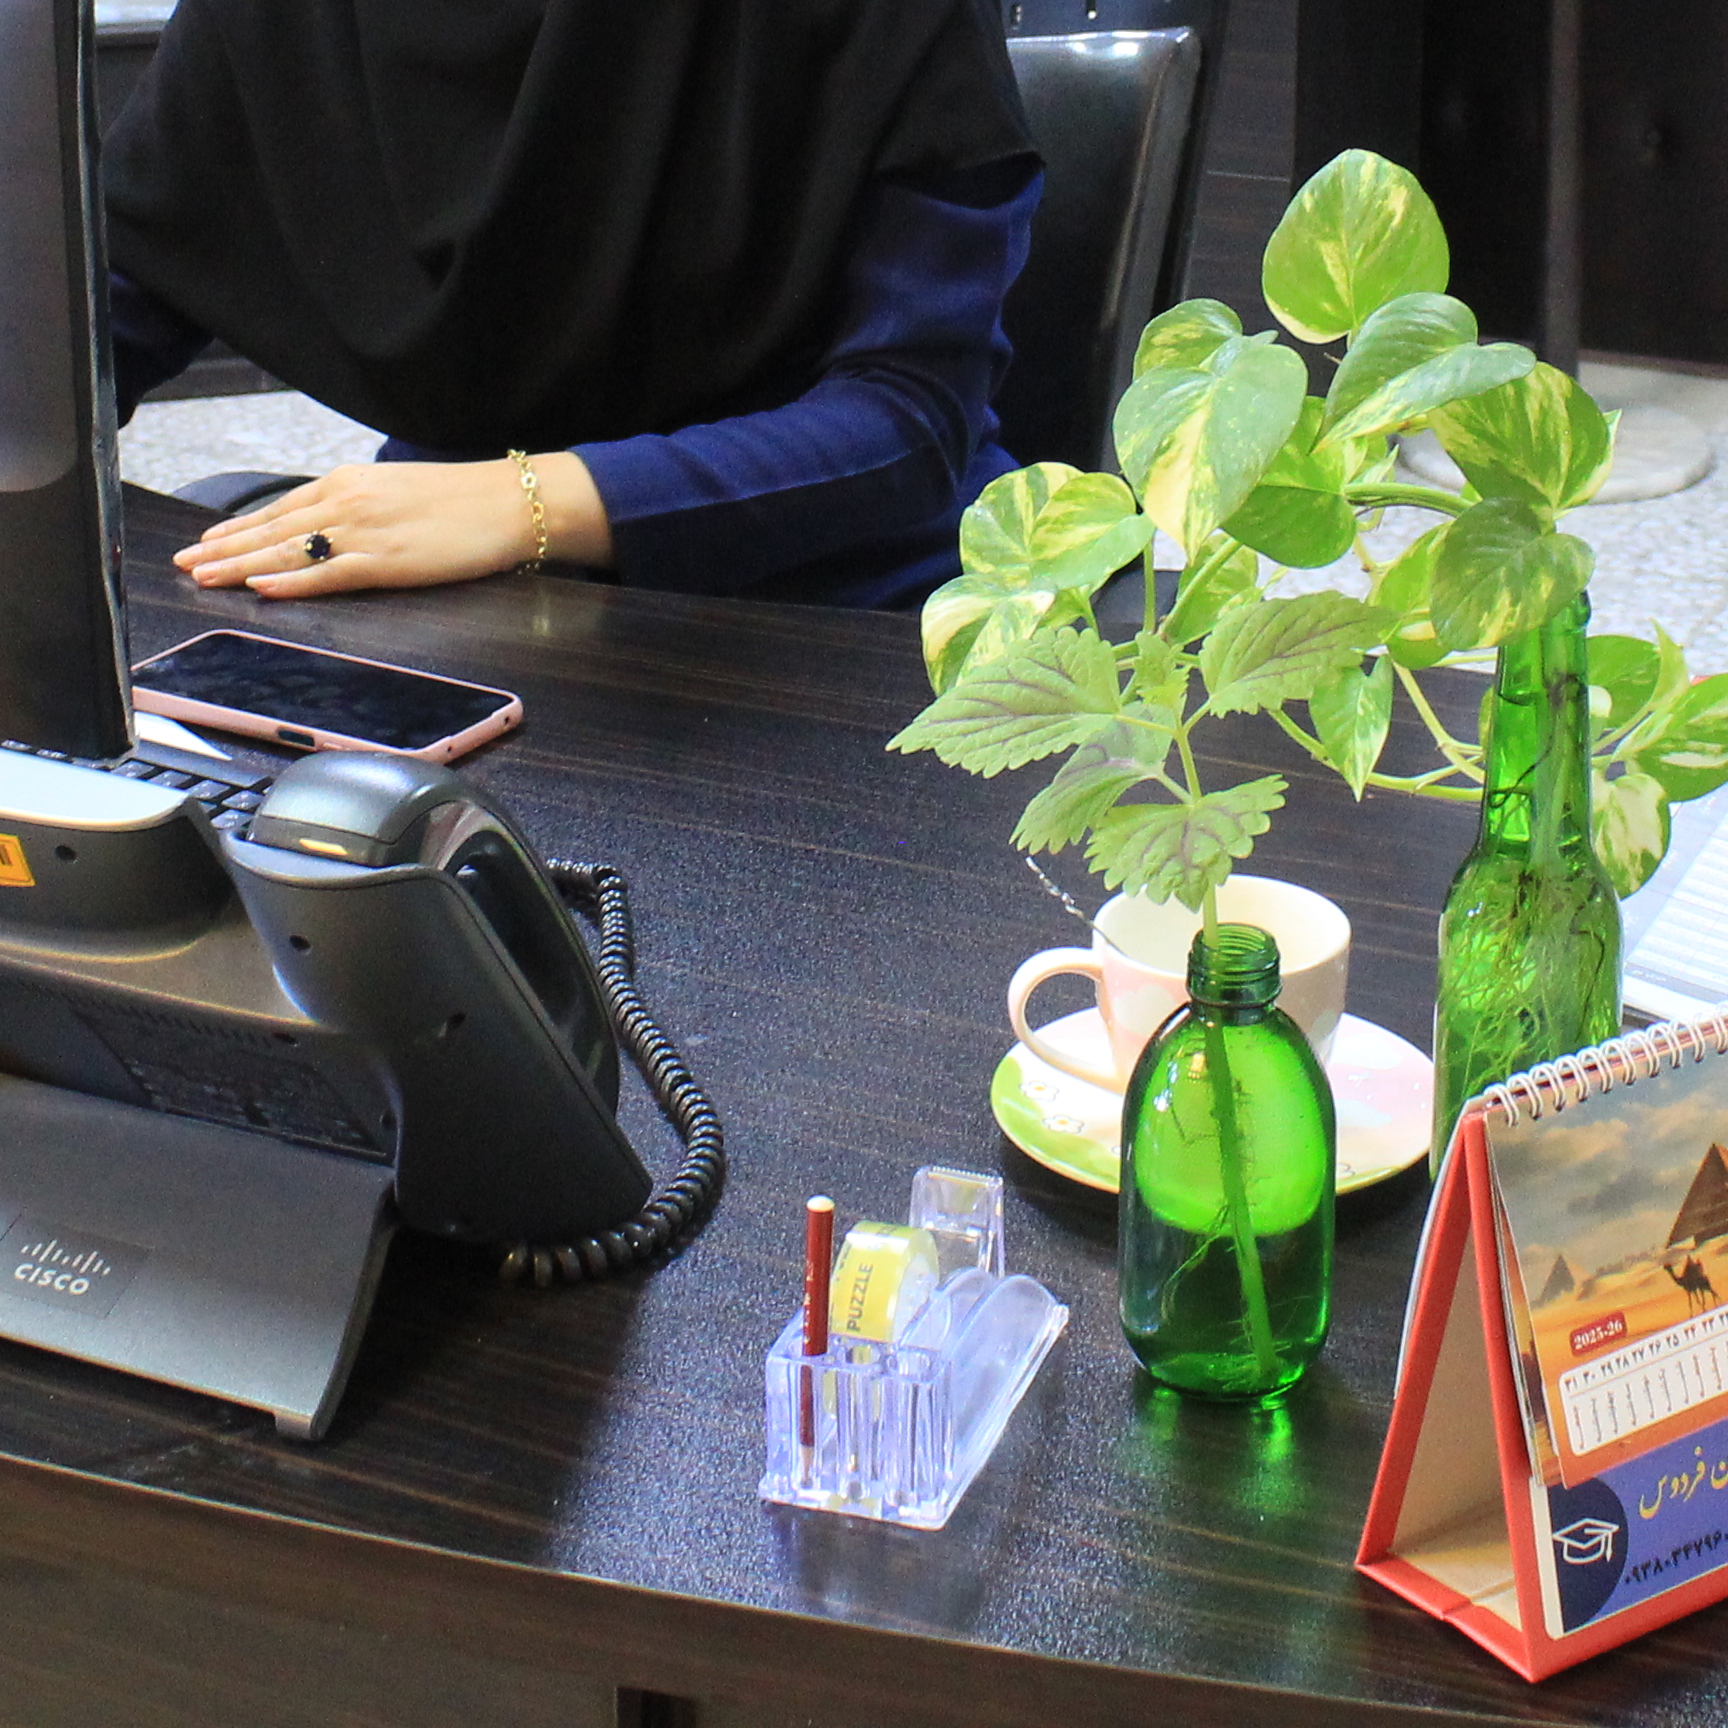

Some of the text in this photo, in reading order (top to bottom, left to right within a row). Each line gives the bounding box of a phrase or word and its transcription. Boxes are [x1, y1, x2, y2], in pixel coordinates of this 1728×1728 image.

[846, 1262, 874, 1333] PUZZLE
[1573, 1319, 1623, 1350] 2025-26
[1639, 1446, 1707, 1519] فردوس
